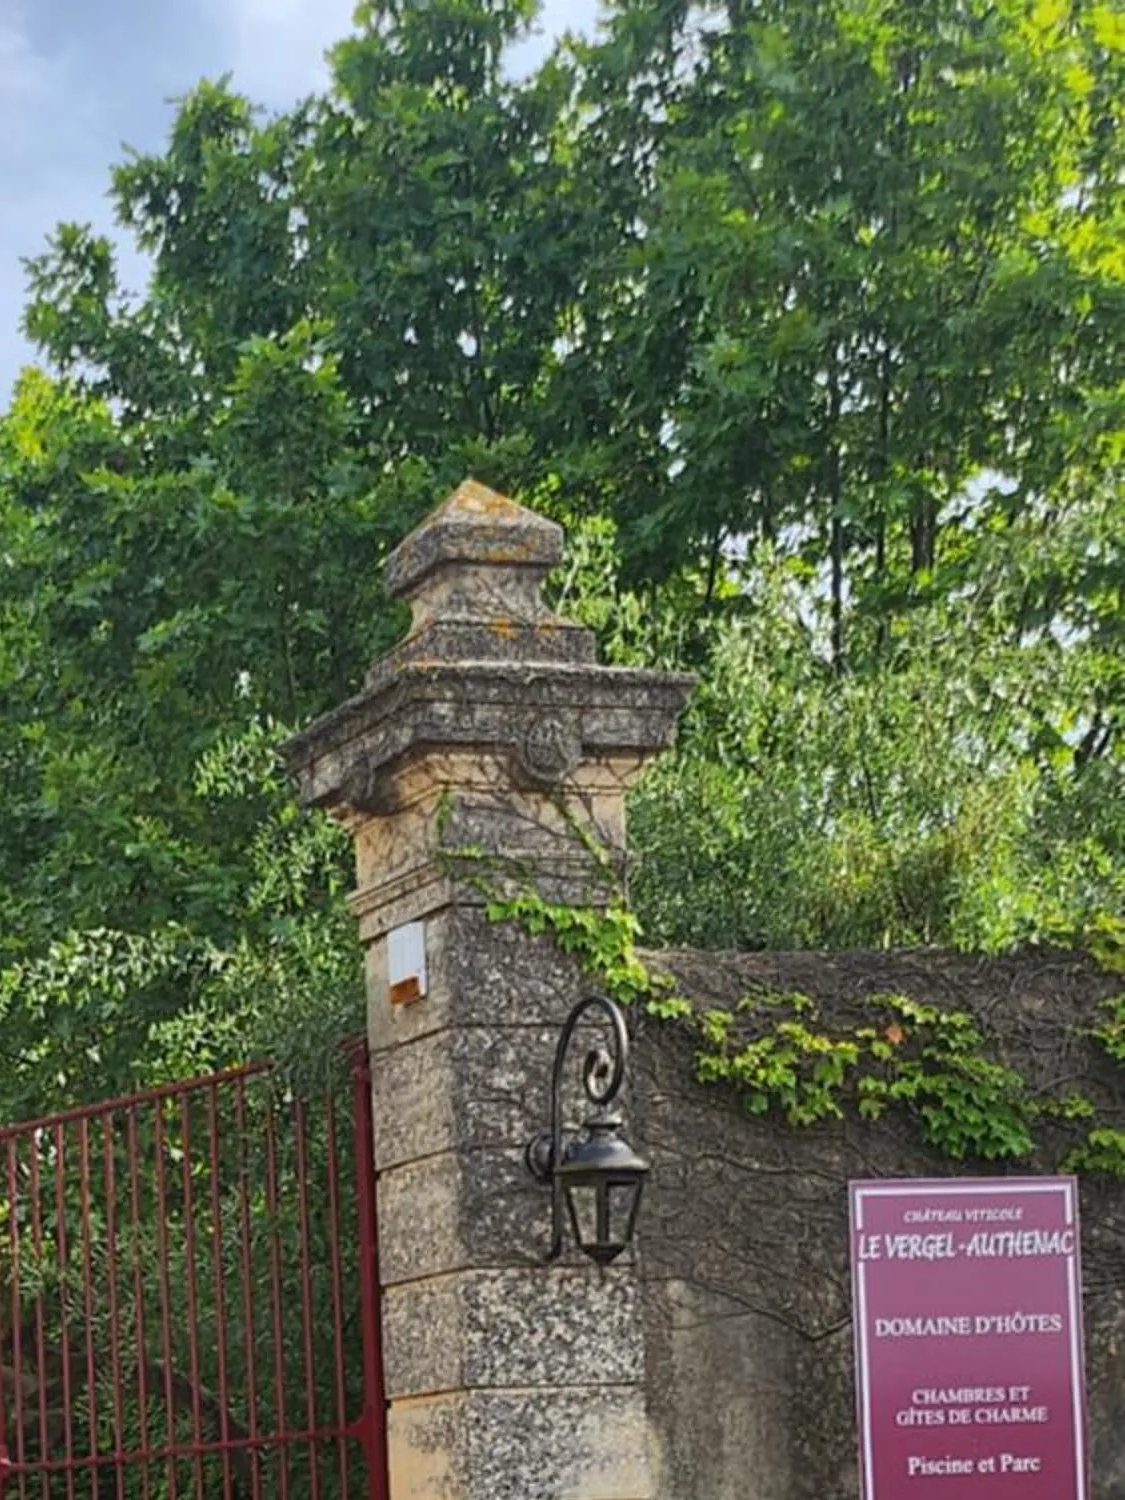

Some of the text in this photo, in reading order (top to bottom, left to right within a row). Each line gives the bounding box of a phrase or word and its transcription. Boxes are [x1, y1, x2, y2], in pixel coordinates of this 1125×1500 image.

[965, 1206, 1024, 1222] VITICOLE
[858, 1234, 881, 1260] LE
[885, 1231, 956, 1261] VERGEL
[967, 1229, 1075, 1258] AUTHENAC
[876, 1311, 1062, 1337] DOMAINE D'HÔTES
[912, 1386, 1031, 1404] CHAMBRES ET
[896, 1406, 1048, 1426] GÎTES DE CHARME
[907, 1453, 1041, 1476] Piscine et Parc
